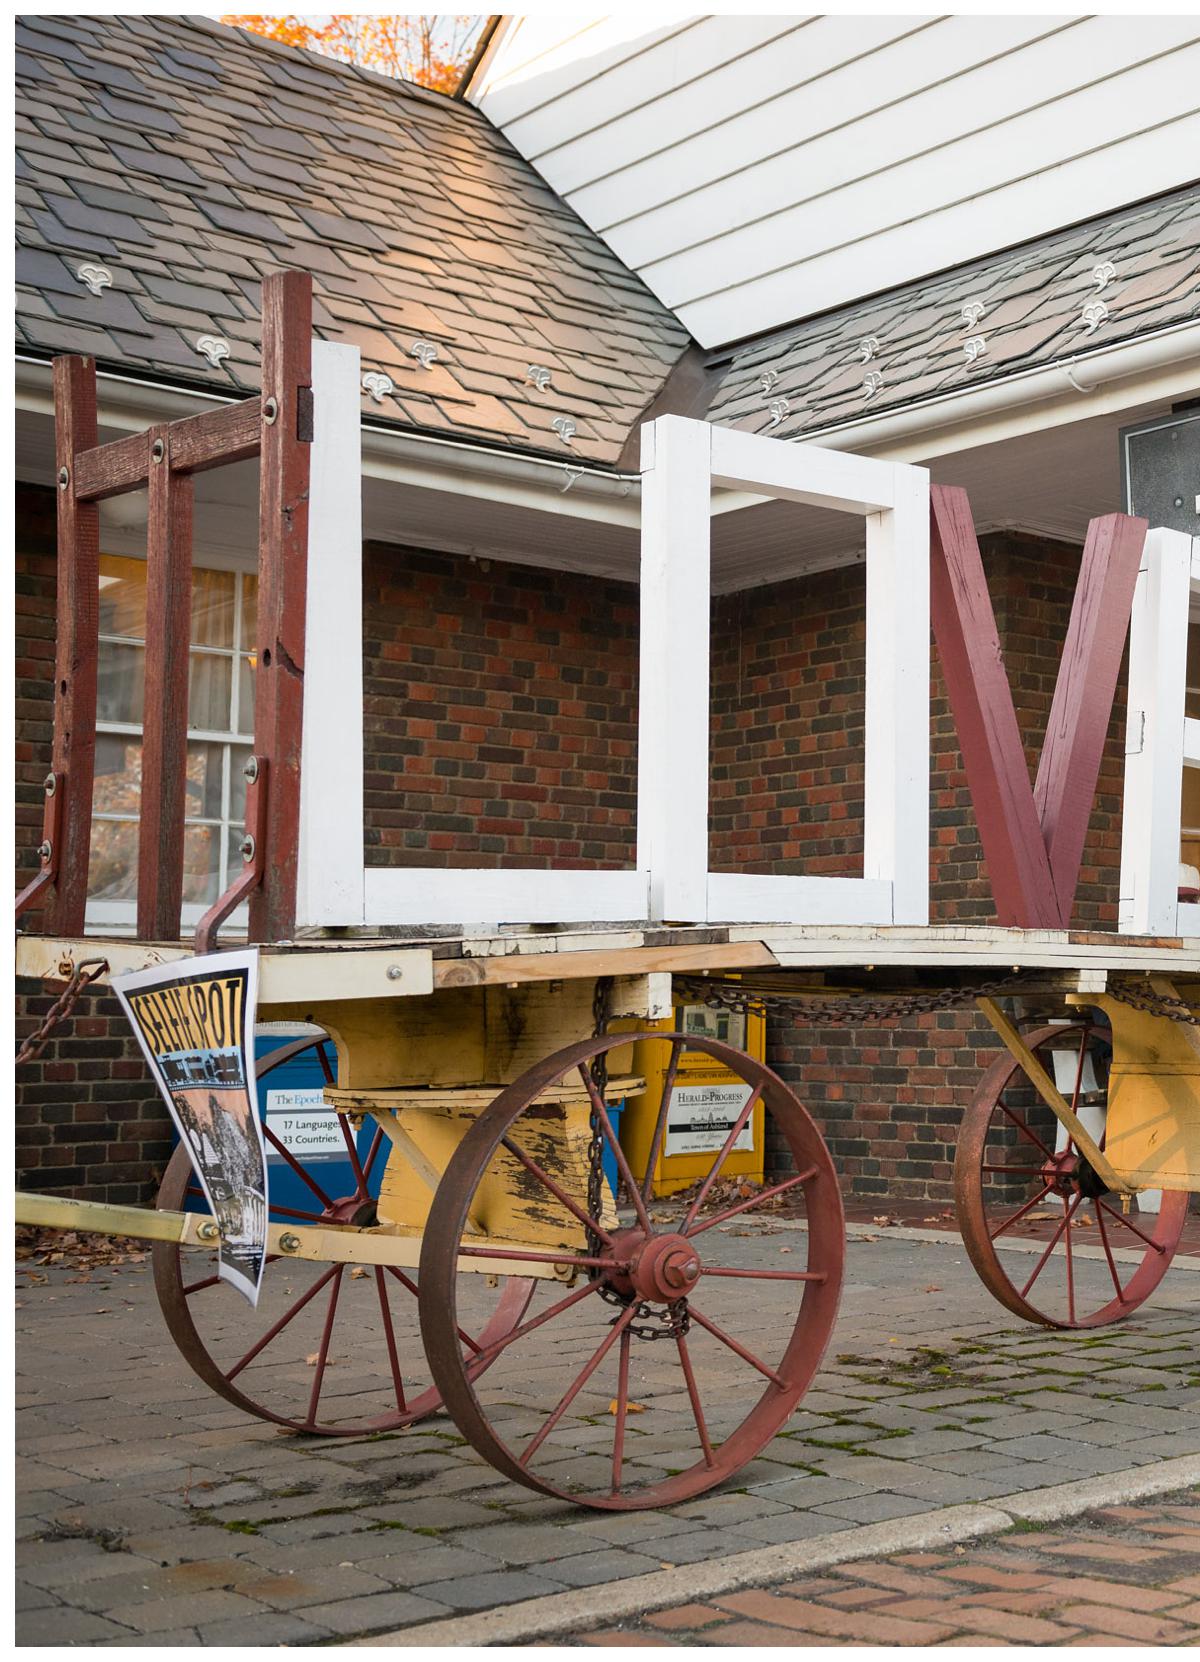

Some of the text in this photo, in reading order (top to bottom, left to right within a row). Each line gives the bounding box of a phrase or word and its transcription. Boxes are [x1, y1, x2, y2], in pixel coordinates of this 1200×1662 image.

[275, 1092, 323, 1106] The Epoch
[283, 1120, 293, 1130] 17
[283, 1133, 340, 1145] 33 Countries.
